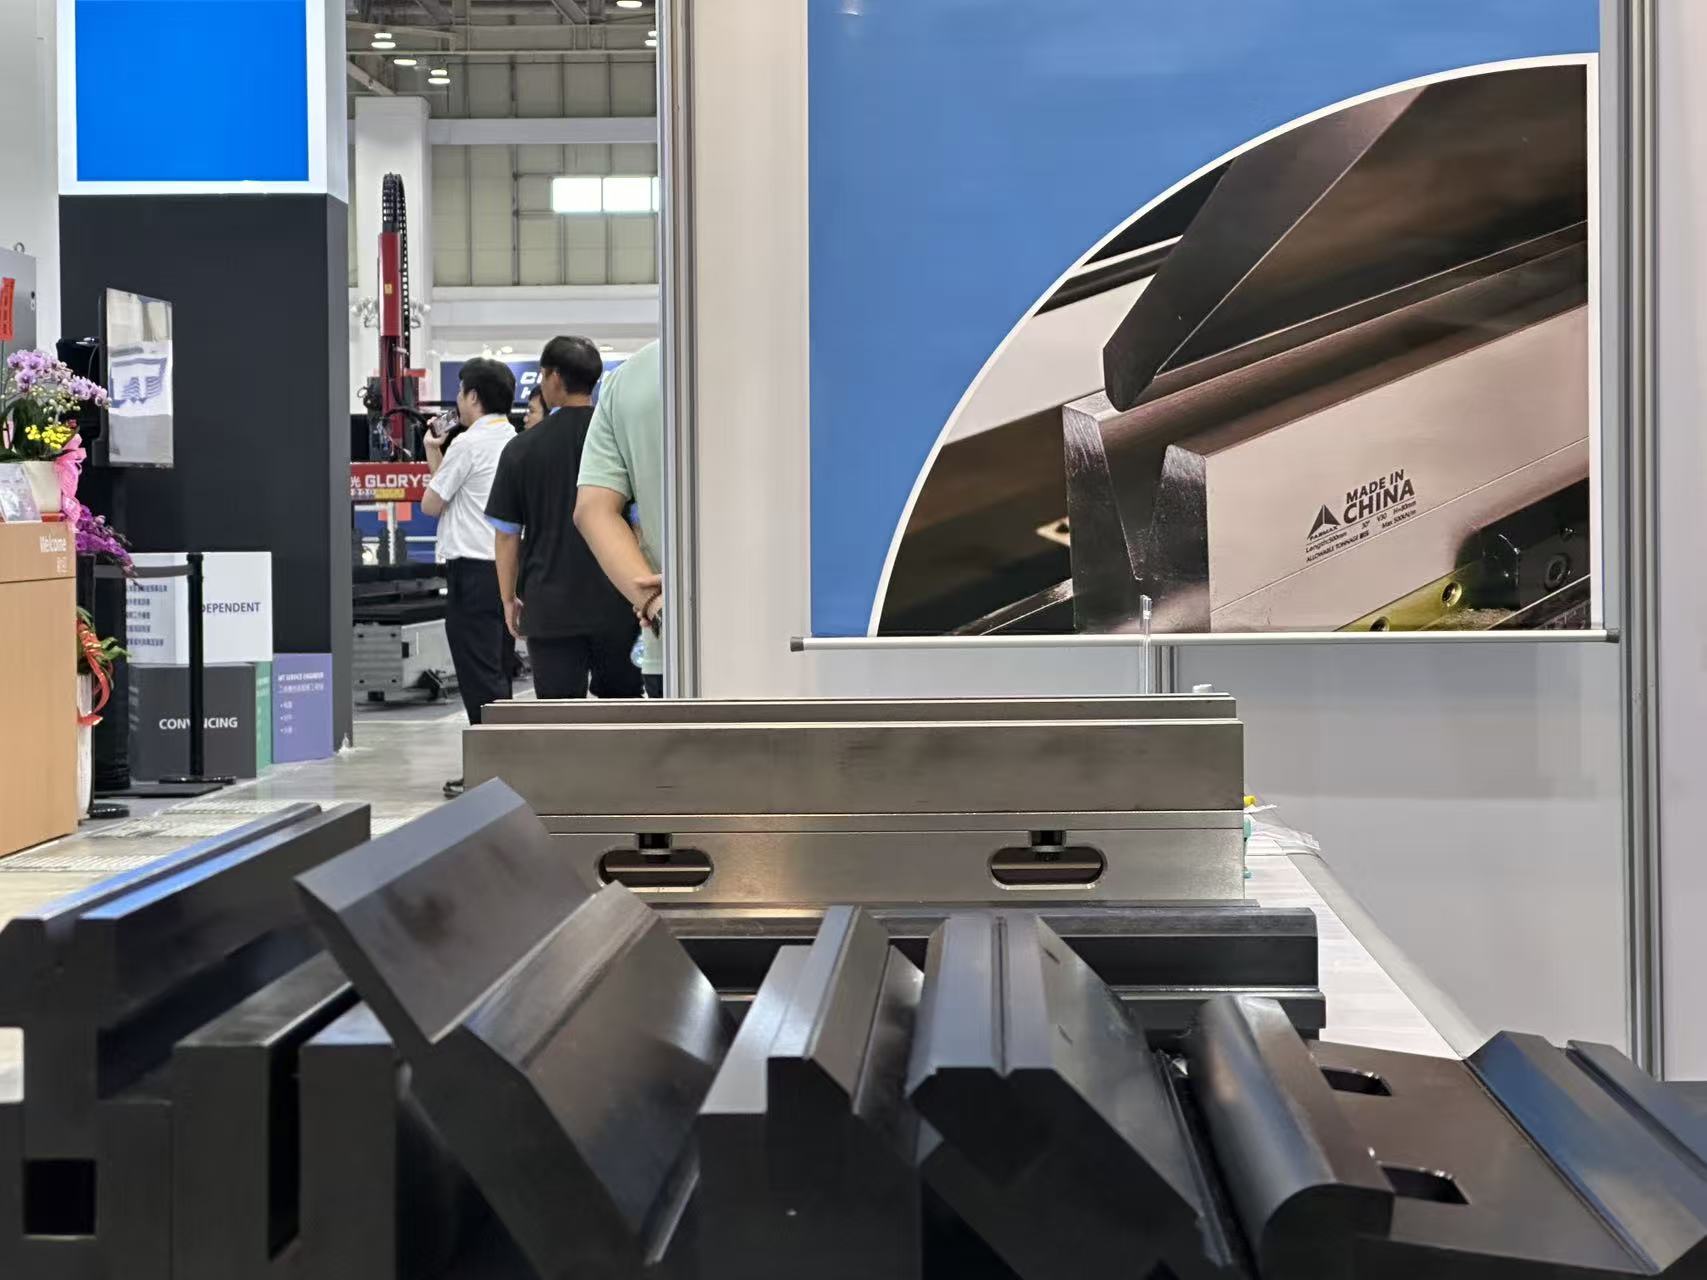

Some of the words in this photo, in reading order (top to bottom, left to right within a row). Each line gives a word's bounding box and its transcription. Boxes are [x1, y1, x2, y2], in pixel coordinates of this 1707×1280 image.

[364, 474, 432, 488] GLORYS
[1346, 477, 1386, 504] MADE
[1390, 469, 1404, 485] IN
[1343, 479, 1415, 524] CHINA
